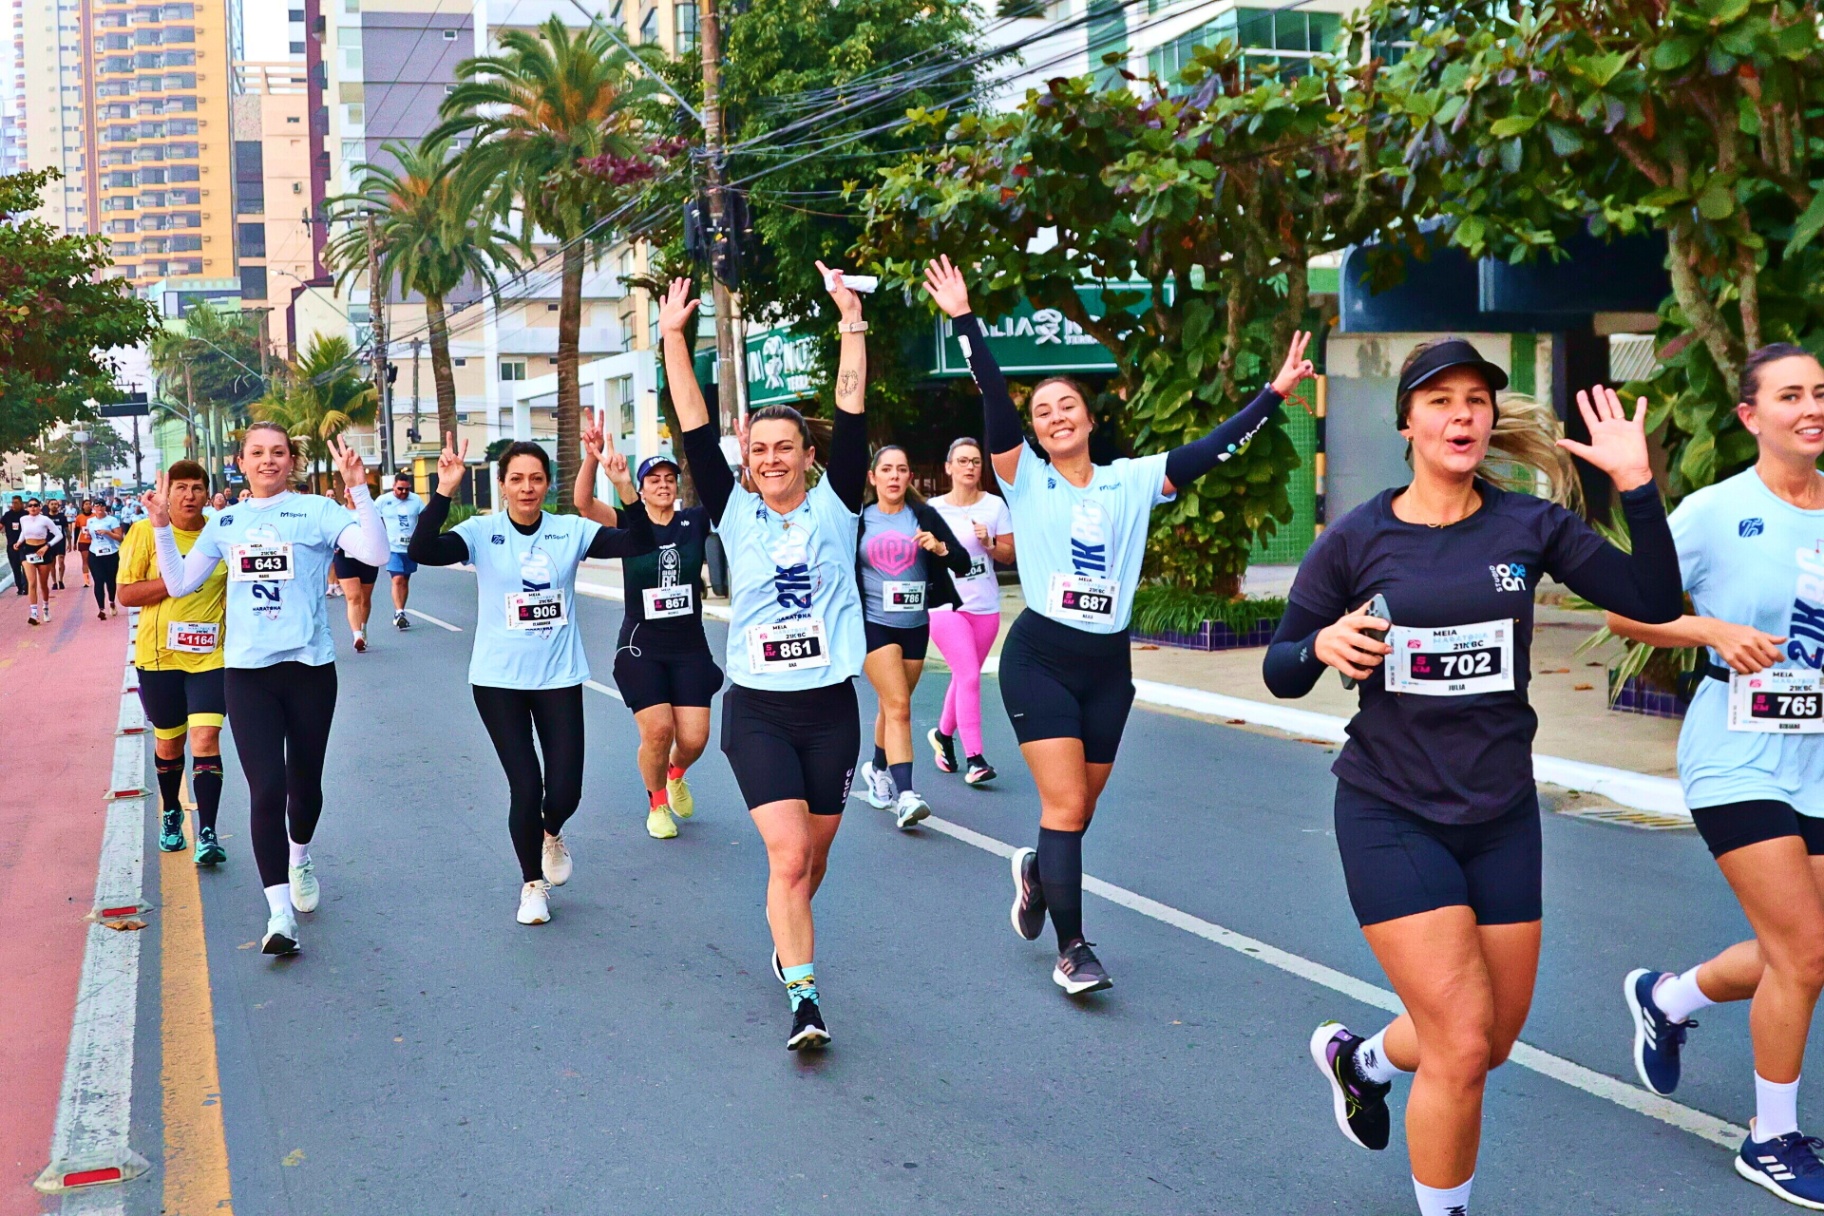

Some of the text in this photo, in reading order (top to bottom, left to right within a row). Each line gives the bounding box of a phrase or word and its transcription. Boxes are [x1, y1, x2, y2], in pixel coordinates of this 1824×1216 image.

[945, 317, 1035, 338] IALIA
[255, 558, 282, 570] 643
[665, 597, 685, 609] 867
[903, 594, 919, 604] 786
[1079, 595, 1108, 611] 687
[533, 605, 557, 619] 906
[187, 635, 213, 645] 1164
[1433, 629, 1458, 637] MEIA
[780, 639, 812, 658] 861
[1440, 652, 1491, 677] 702
[1777, 696, 1817, 716] 765
